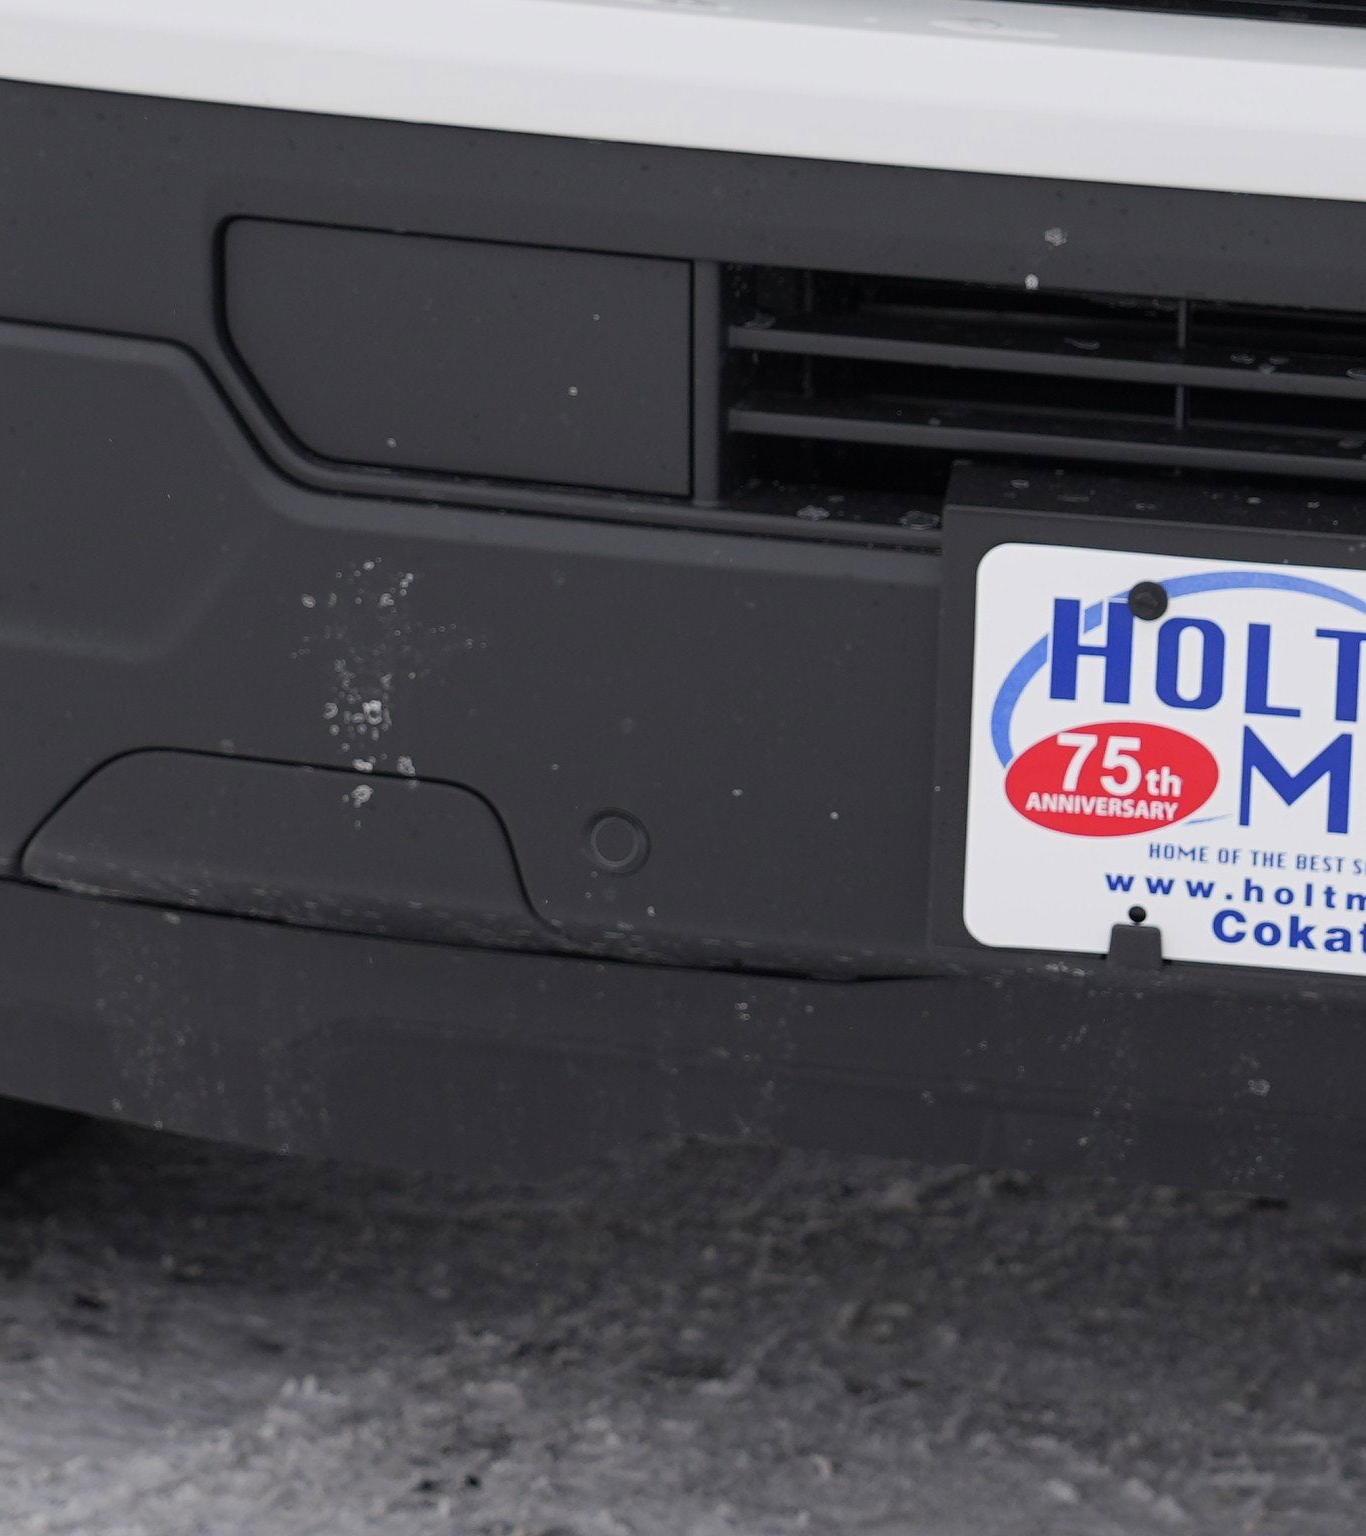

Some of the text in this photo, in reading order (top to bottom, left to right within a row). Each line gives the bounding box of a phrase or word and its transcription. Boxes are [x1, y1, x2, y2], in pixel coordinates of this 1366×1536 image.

[1055, 731, 1183, 799] 75th
[1024, 790, 1181, 822] ANNIVERSARY
[1148, 842, 1209, 864] HOME
[1217, 847, 1242, 866] OF
[1249, 849, 1287, 869] THE
[1295, 853, 1345, 874] BEST
